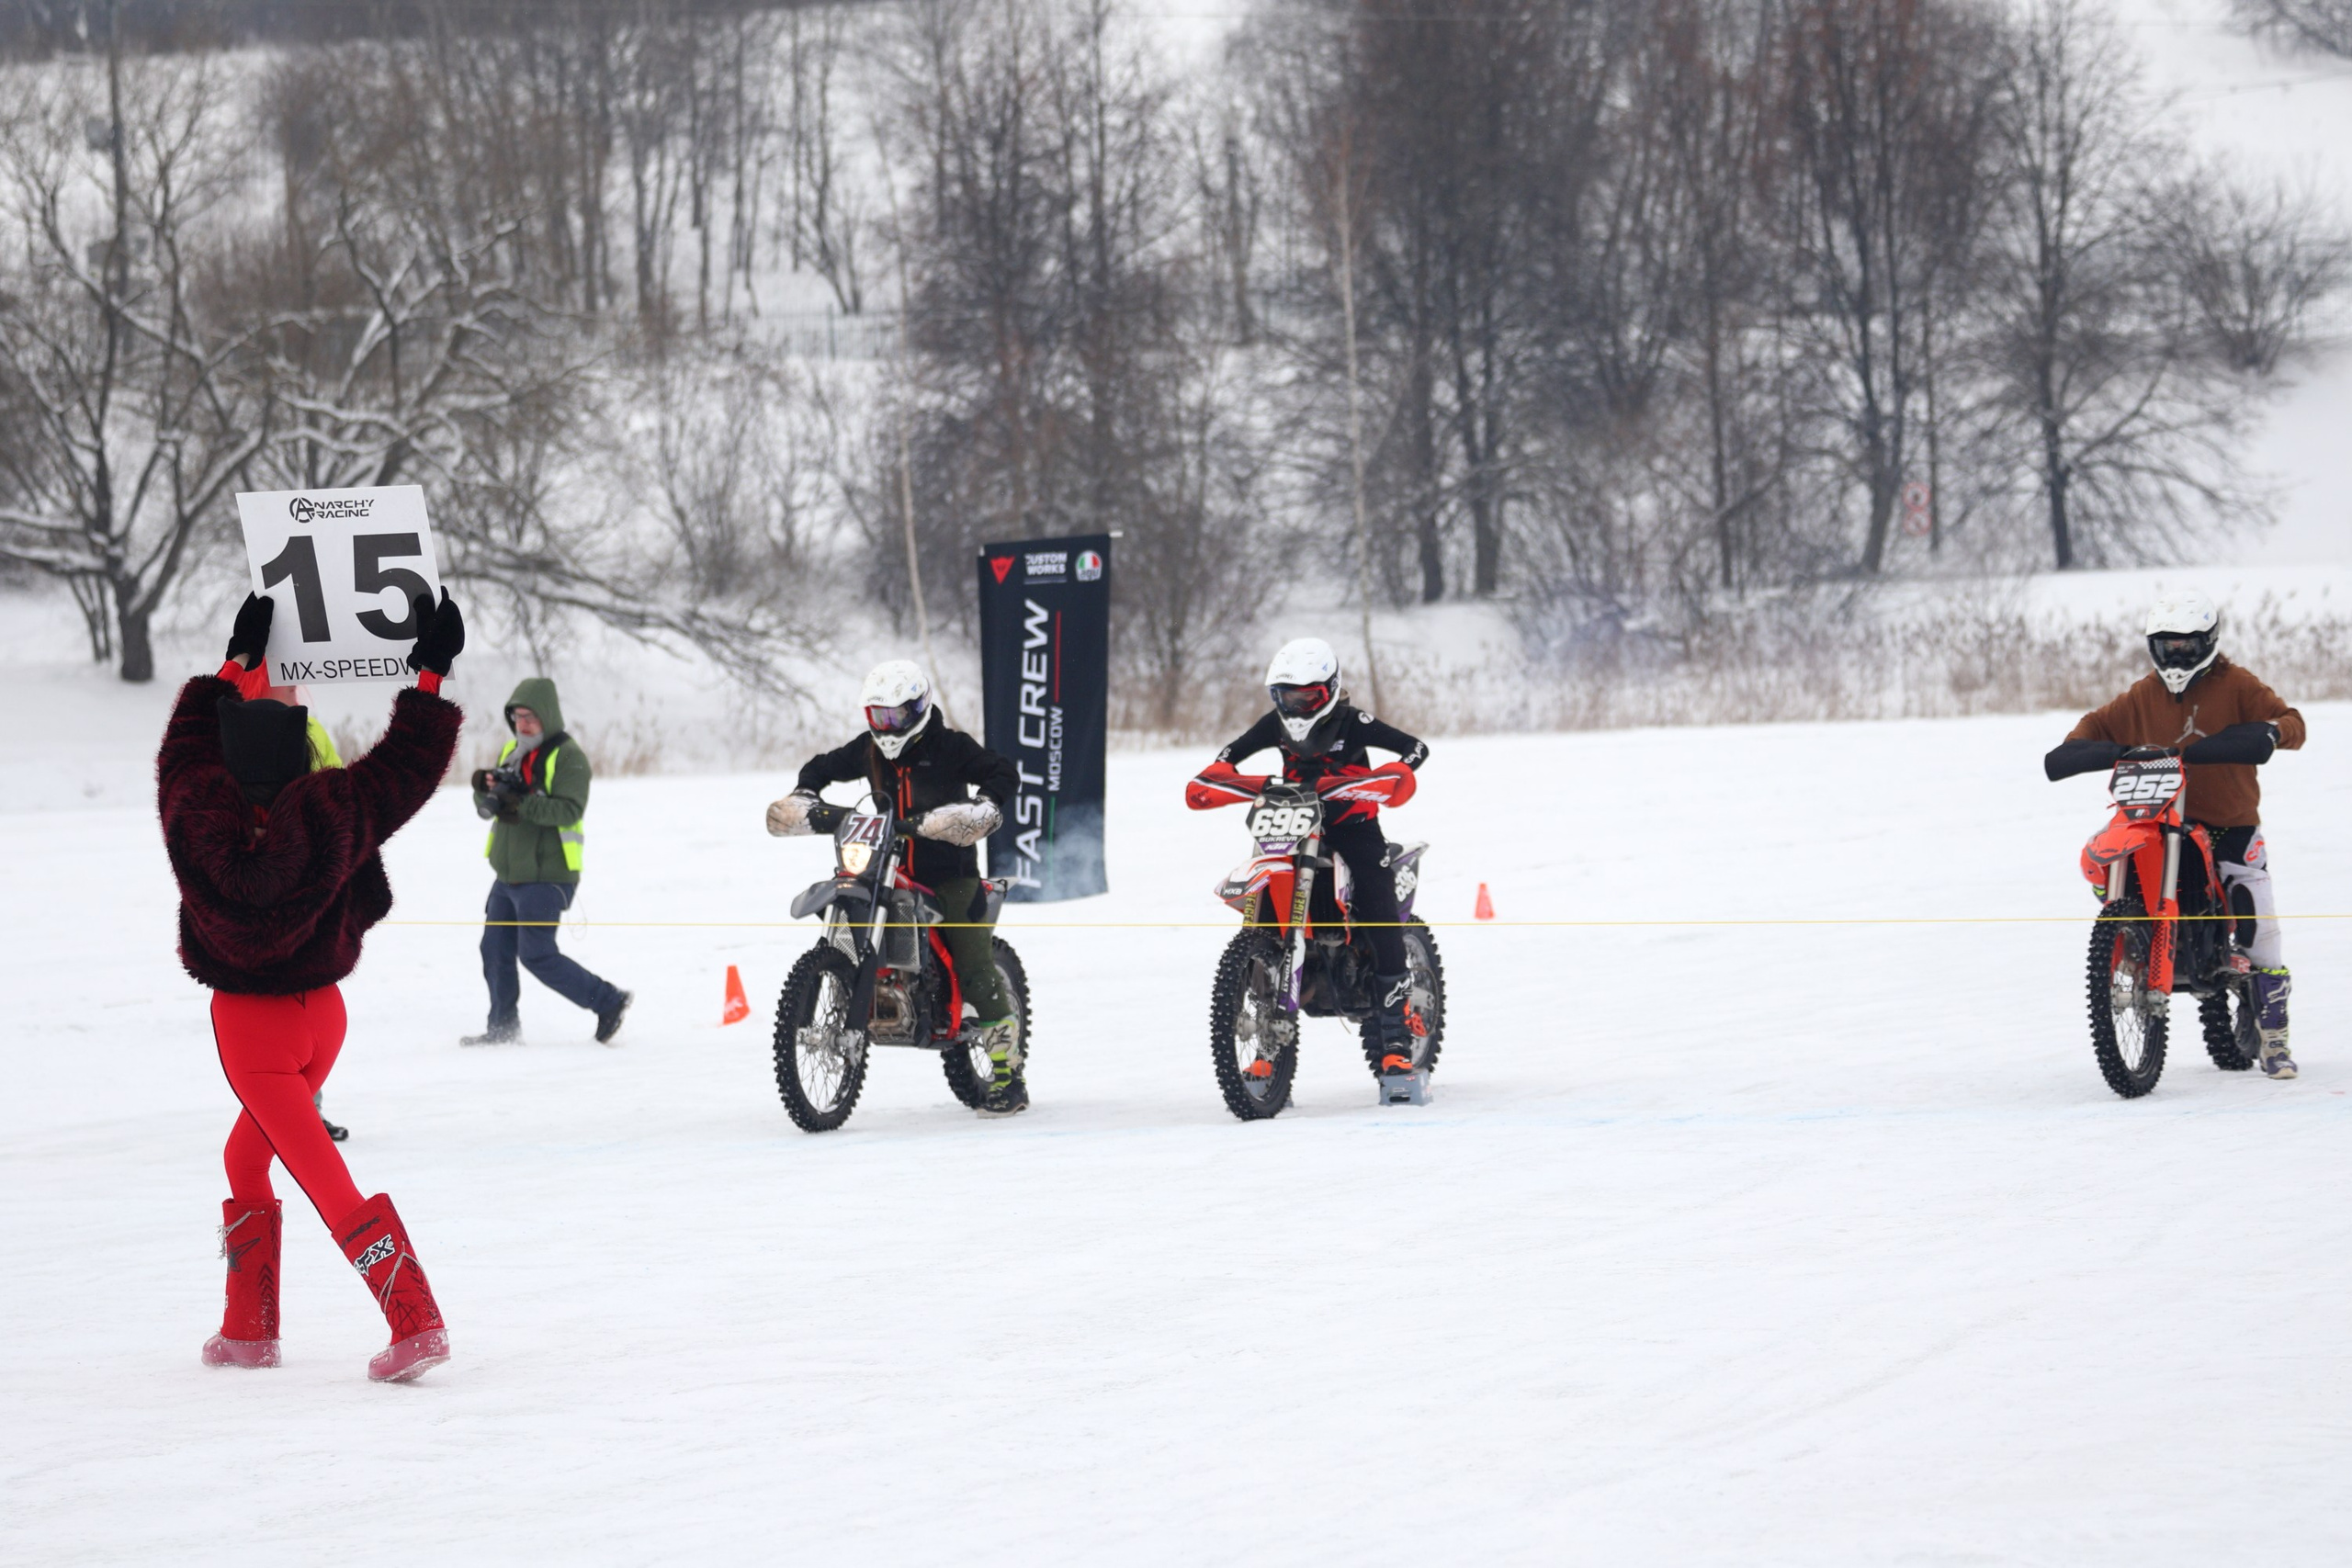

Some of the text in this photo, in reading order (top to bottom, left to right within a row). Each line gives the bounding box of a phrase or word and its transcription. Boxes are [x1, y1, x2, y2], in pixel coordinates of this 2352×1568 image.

[316, 509, 369, 519] RACING
[1027, 564, 1066, 575] WORKS
[261, 532, 436, 643] 15
[1015, 598, 1049, 888] FAST CREW
[1047, 706, 1064, 792] MOSCOW
[2113, 773, 2183, 801] 252
[841, 815, 888, 851] 74
[1251, 807, 1315, 836] 696
